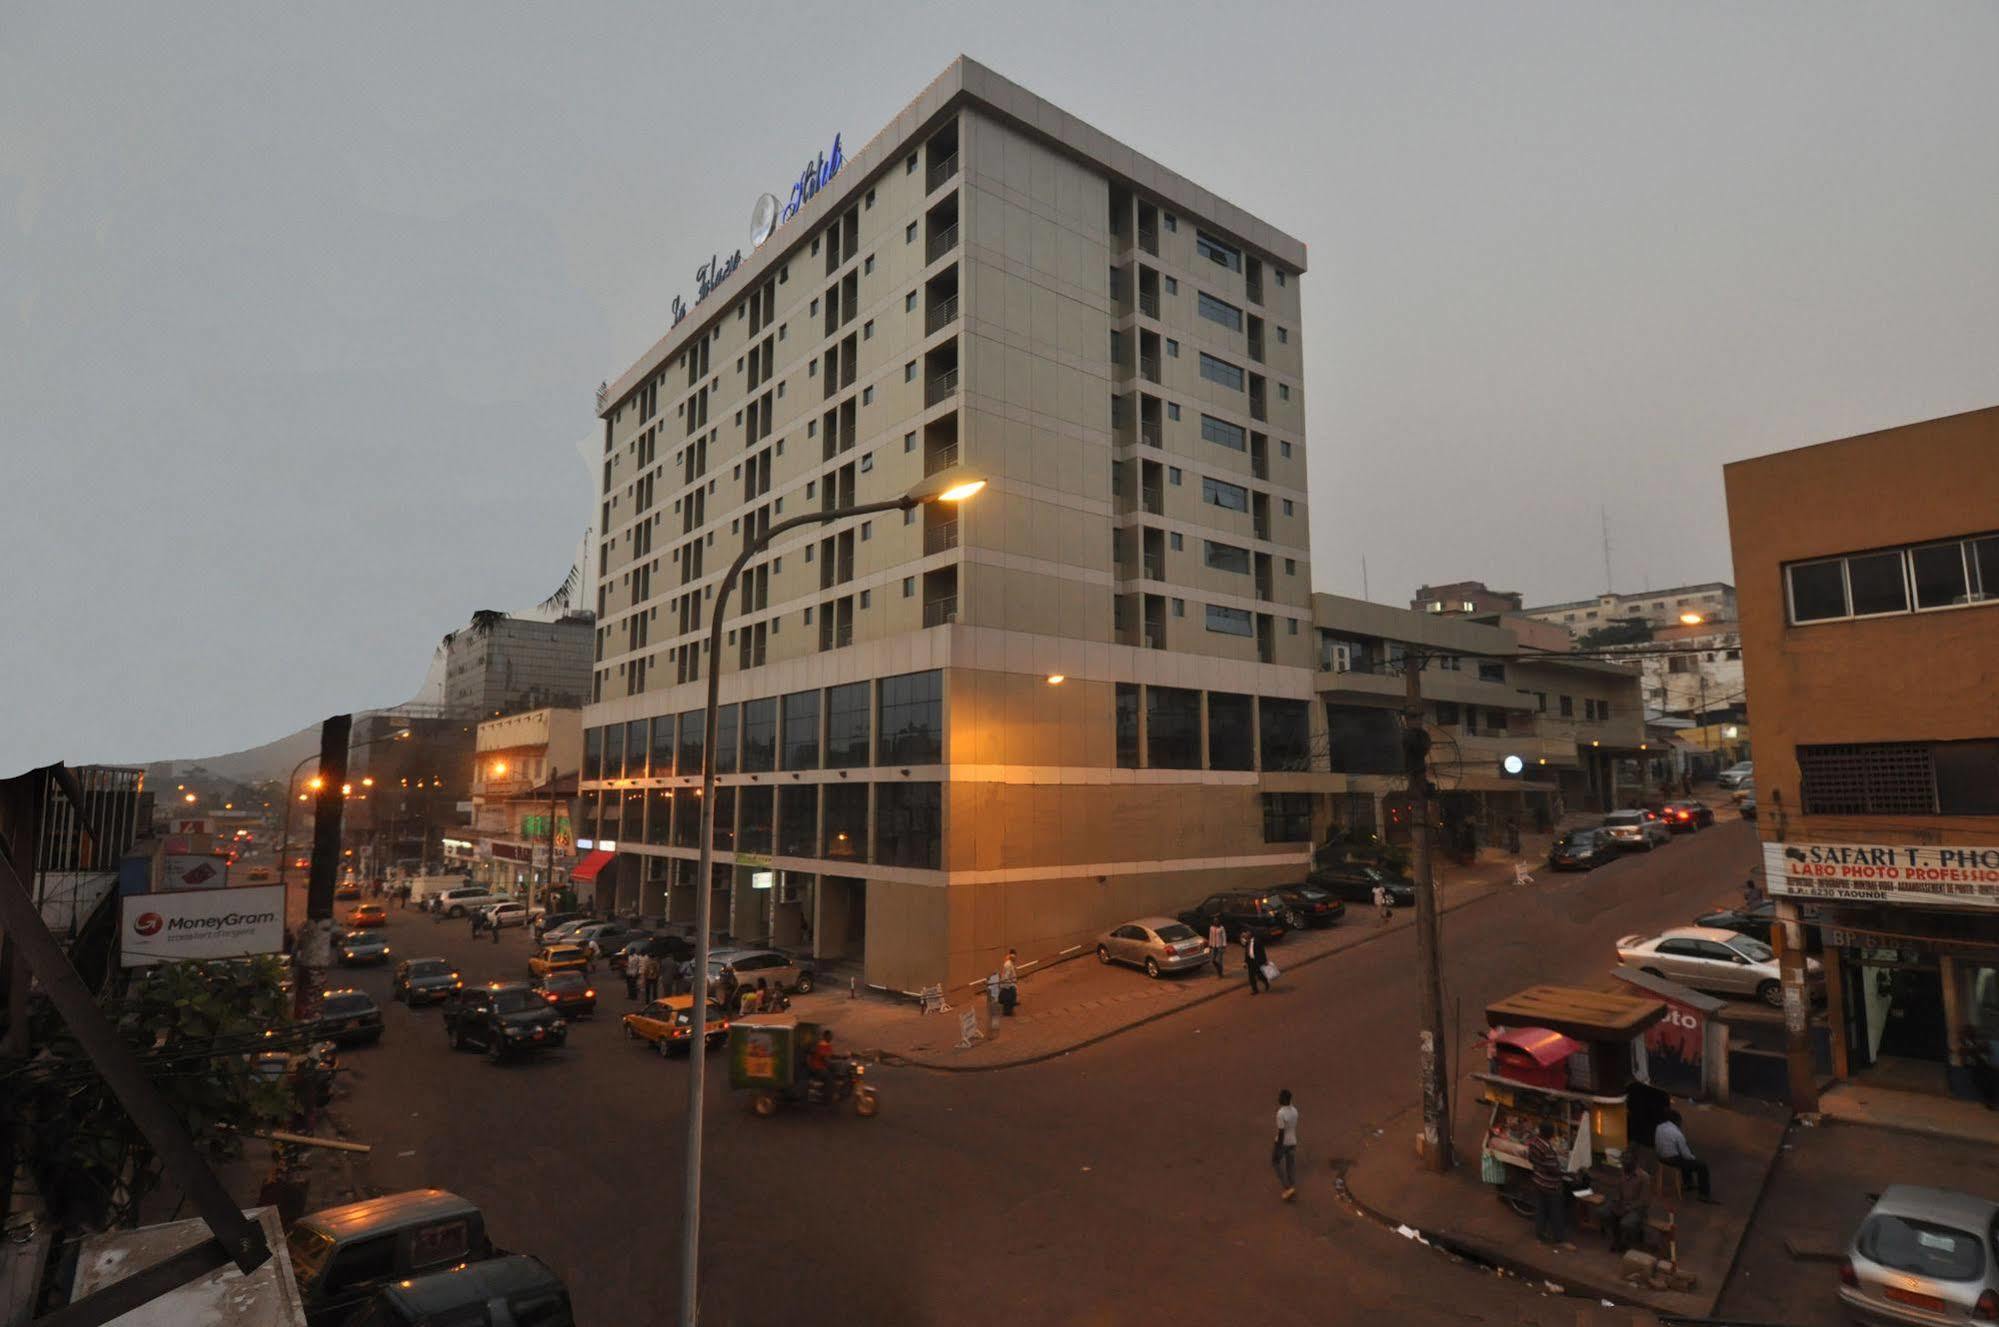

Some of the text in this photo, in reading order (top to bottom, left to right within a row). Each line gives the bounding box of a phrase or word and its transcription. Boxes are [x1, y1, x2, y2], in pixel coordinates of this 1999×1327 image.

[1810, 846, 1895, 866] SAFARI
[1904, 848, 1929, 867] T.
[1792, 863, 1999, 882] LABO PHOTO PROFESSIO
[1838, 889, 1888, 899] YAOUNDE
[168, 912, 274, 930] MoneyGram
[1833, 930, 1857, 947] BP
